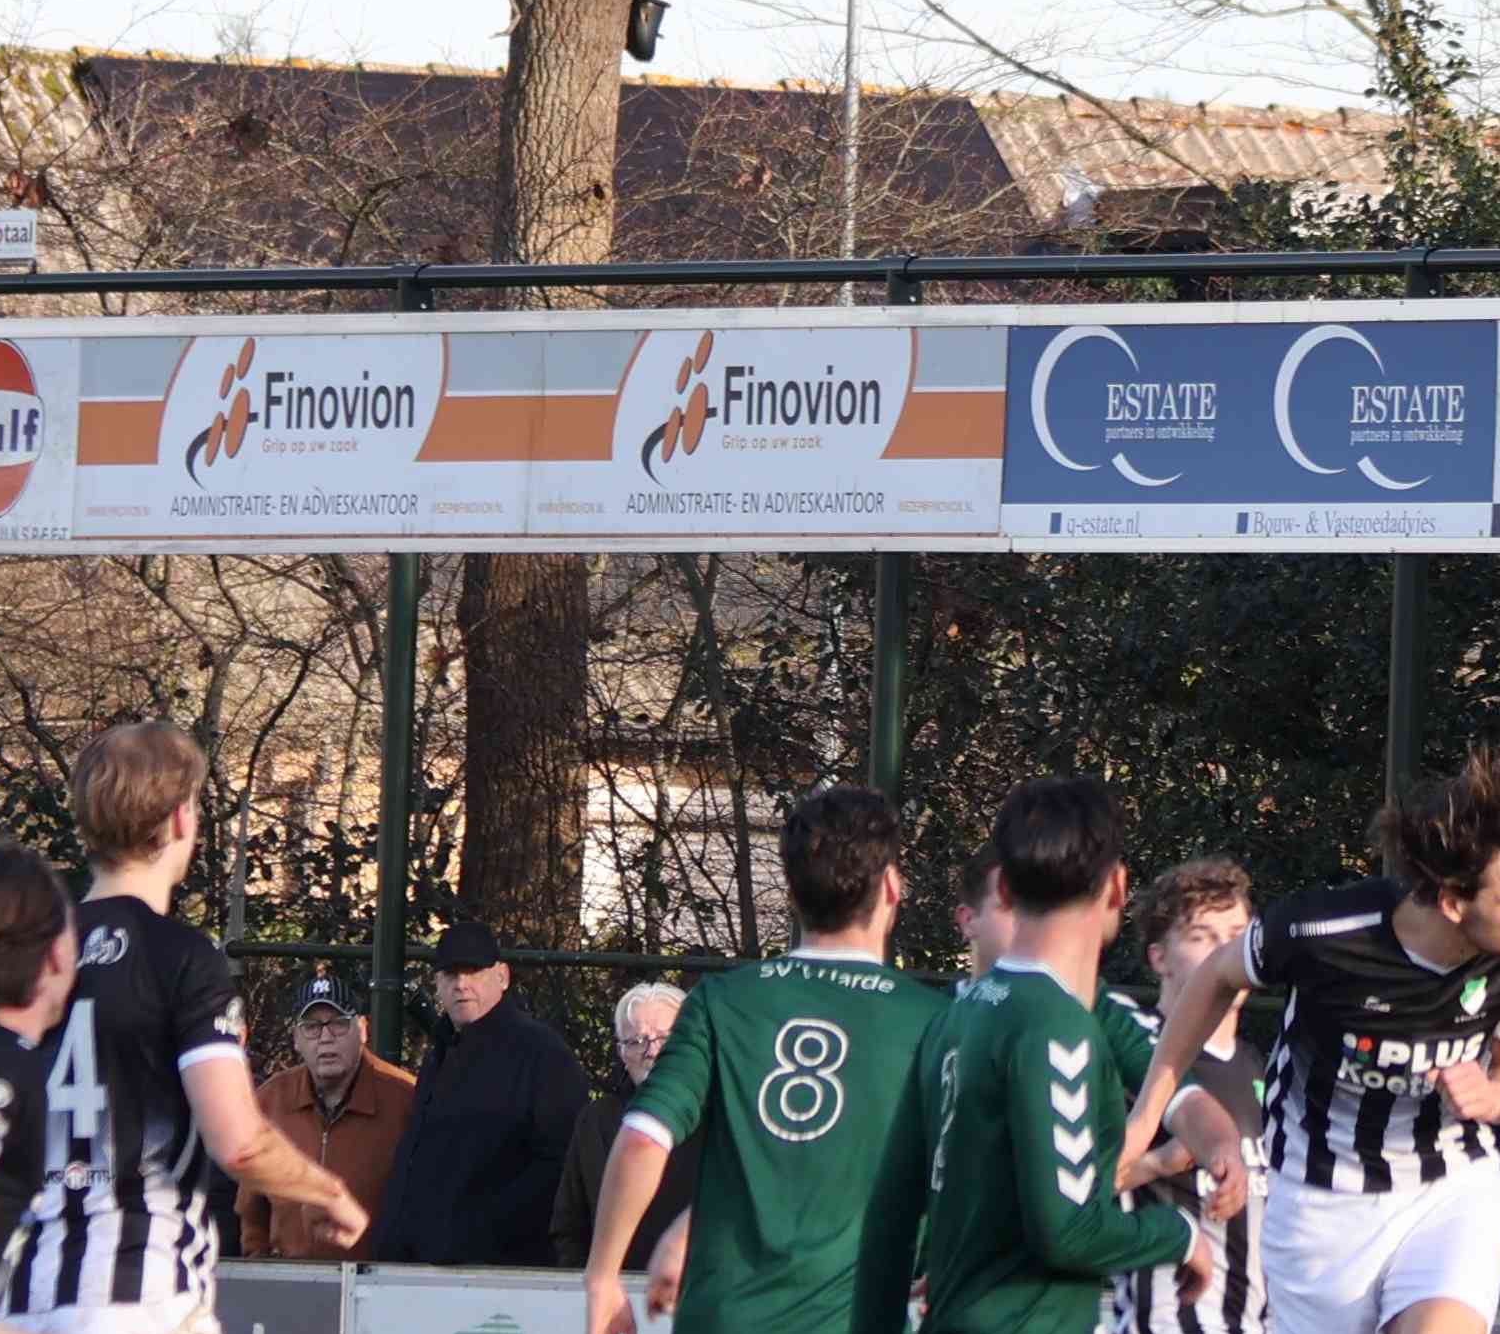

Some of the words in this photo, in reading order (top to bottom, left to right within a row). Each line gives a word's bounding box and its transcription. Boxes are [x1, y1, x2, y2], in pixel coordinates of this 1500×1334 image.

[263, 370, 415, 430] Finovion
[722, 364, 882, 427] Finovion
[1104, 382, 1217, 422] ESTATE
[1350, 384, 1466, 425] ESTATE
[1104, 424, 1145, 444] partners
[1145, 423, 1156, 440] in
[1156, 422, 1216, 443] ontwikkeling
[1350, 425, 1391, 446] partners
[1391, 425, 1403, 442] in
[1403, 424, 1466, 446] ontwikkeling
[170, 493, 277, 517] ADMINISTRATIE-
[279, 494, 299, 516] EN
[301, 493, 419, 516] ADVIESKANTOOR
[625, 491, 739, 516] ADMINISTRATIE-
[741, 492, 761, 514] EN
[763, 491, 885, 514] ADVIESKANTOOR
[1305, 512, 1320, 535] &
[46, 999, 110, 1139] 4
[1377, 1031, 1486, 1074] PLUS
[758, 1016, 849, 1142] 8
